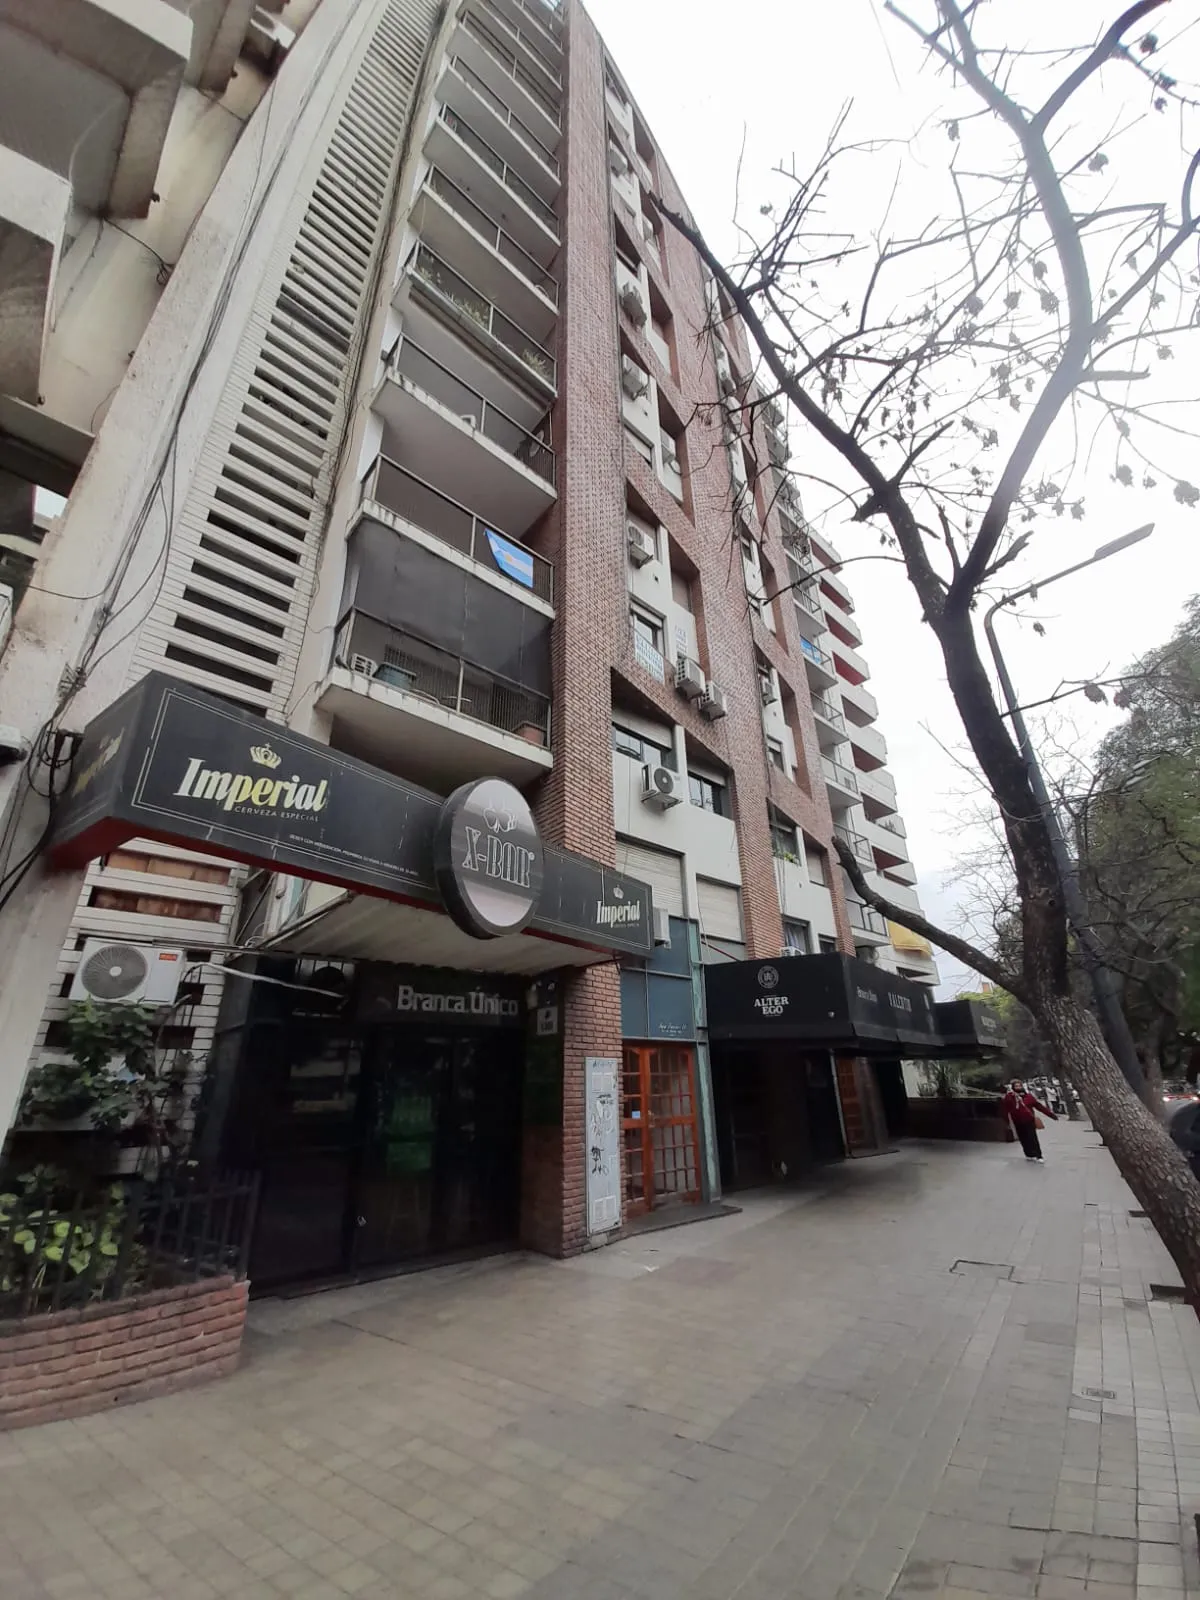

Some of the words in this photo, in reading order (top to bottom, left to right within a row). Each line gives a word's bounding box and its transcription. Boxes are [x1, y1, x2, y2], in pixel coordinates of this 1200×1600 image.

[173, 757, 328, 812] Imperial
[234, 805, 277, 817] CERVEZA
[280, 811, 319, 822] ESPECIAL
[596, 899, 640, 929] Imperial
[468, 985, 519, 1016] Único
[754, 996, 789, 1007] ALTER
[762, 1005, 784, 1015] EGO
